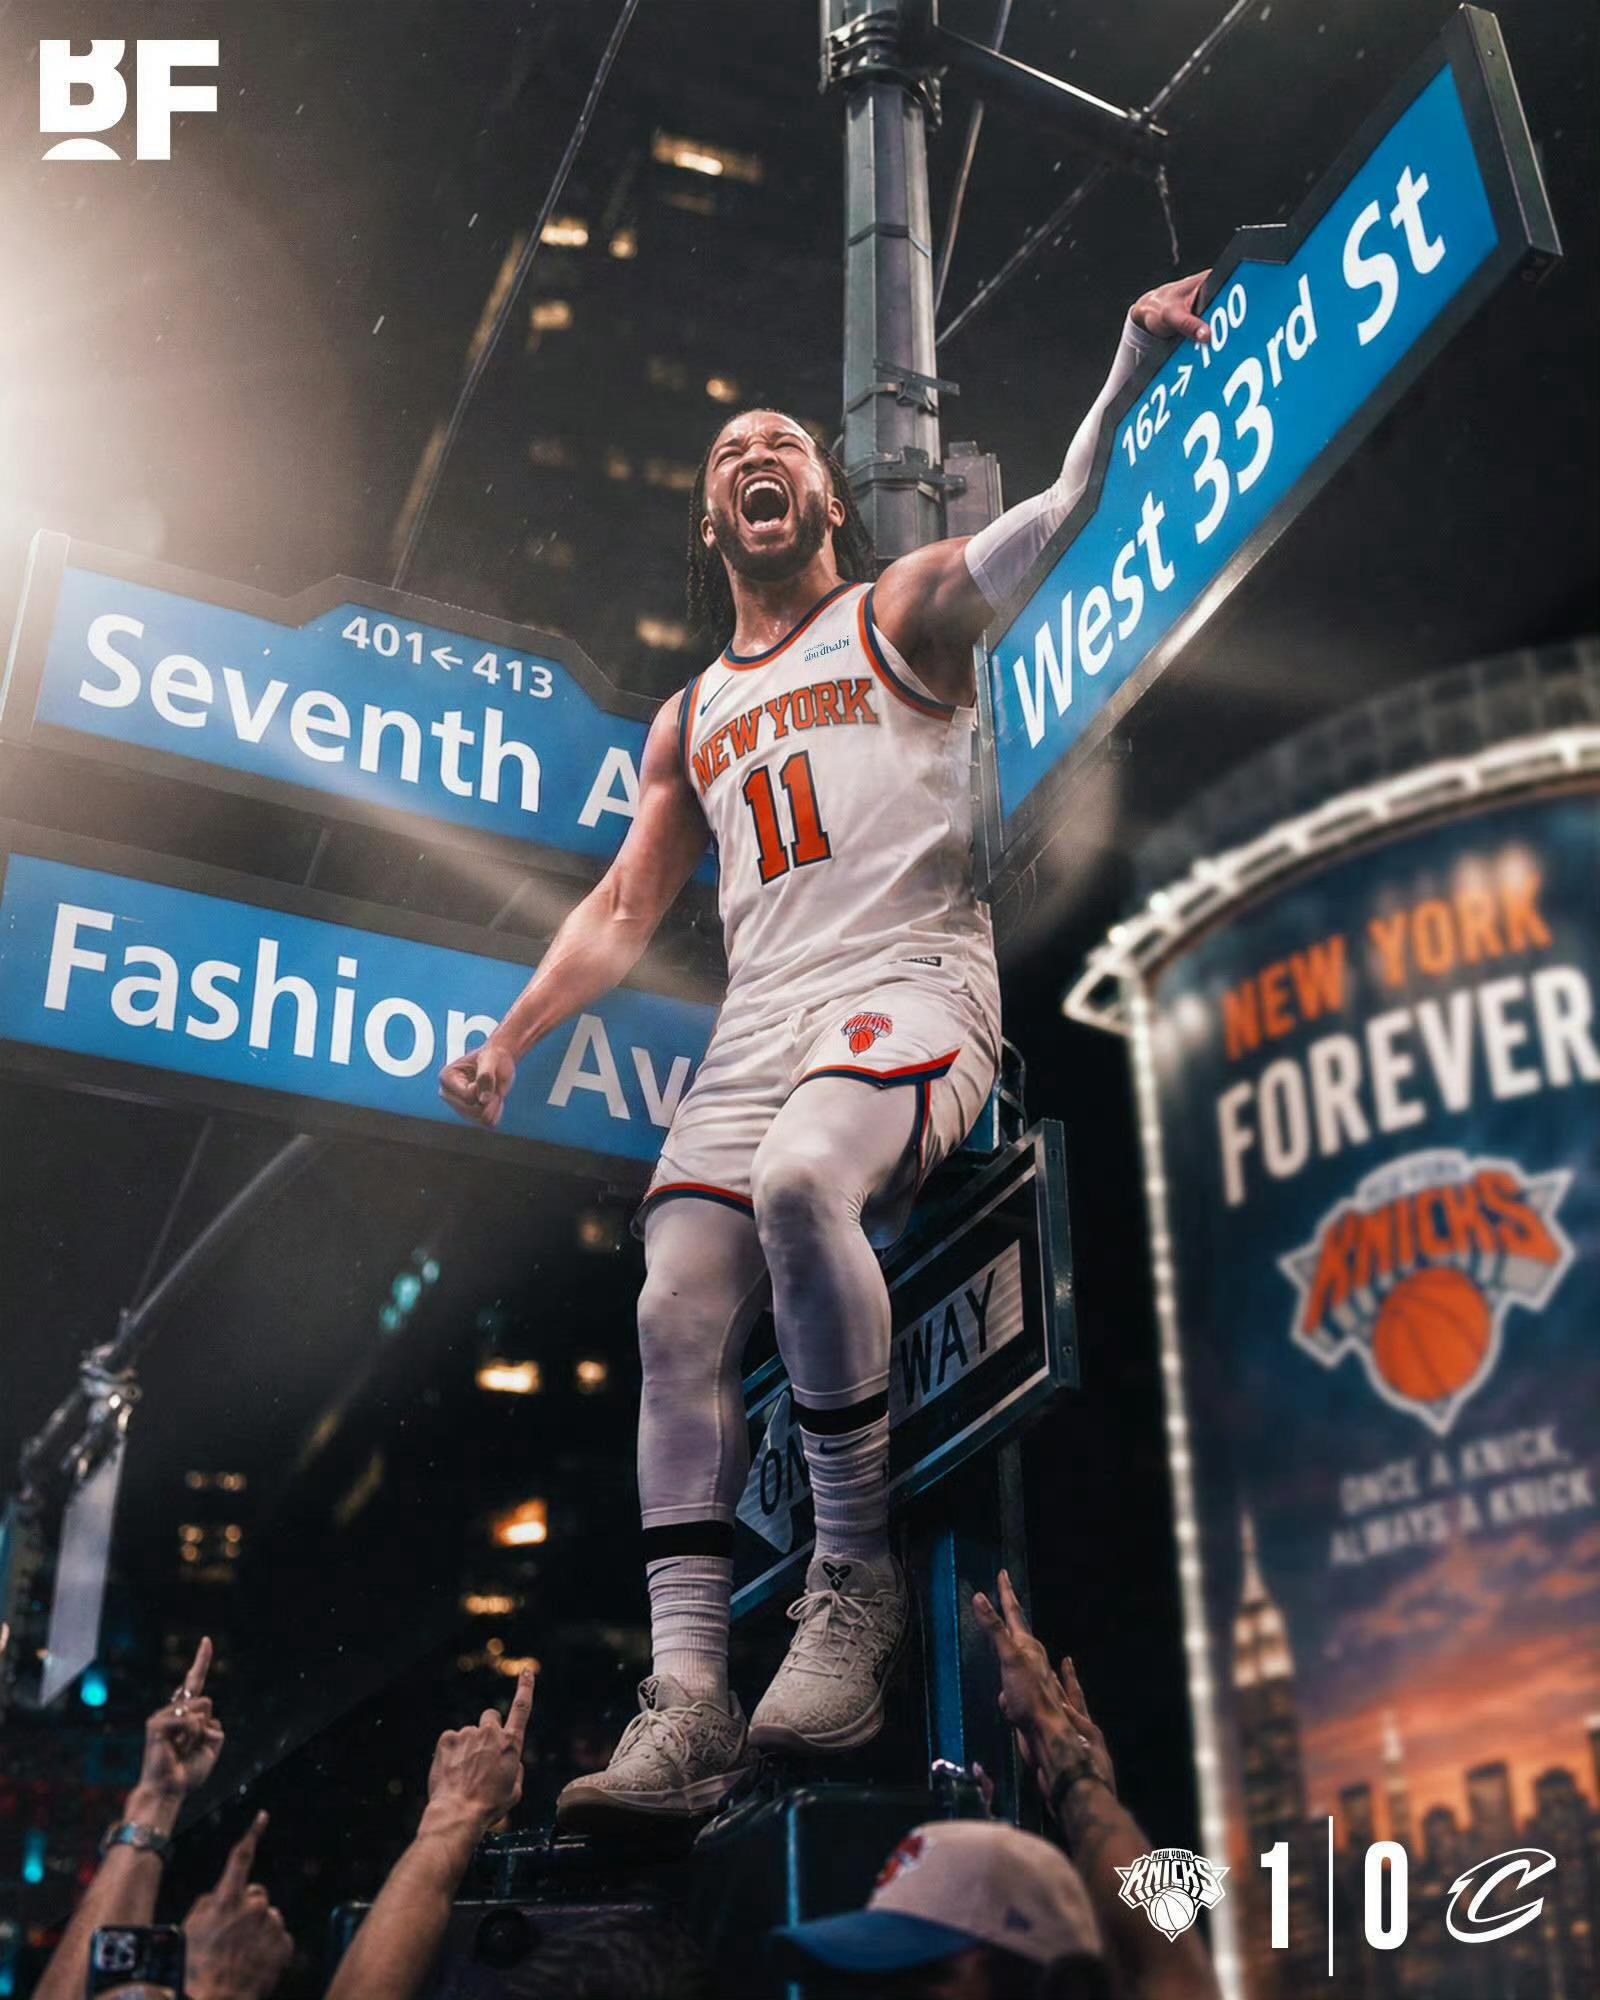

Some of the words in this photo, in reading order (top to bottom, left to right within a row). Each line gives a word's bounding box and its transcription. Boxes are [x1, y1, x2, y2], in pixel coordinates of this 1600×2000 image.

[1011, 490, 1176, 749] West
[1181, 273, 1318, 544] 33rd
[1341, 165, 1447, 347] St
[1121, 383, 1171, 467] 162
[78, 613, 543, 814] Seventh
[341, 614, 424, 665] 401
[471, 651, 554, 700] 413
[692, 706, 763, 799] NEW
[764, 677, 880, 740] YORK
[741, 749, 833, 886] 11
[1222, 934, 1347, 1063] NEW
[1366, 860, 1554, 990] YORK
[546, 1012, 692, 1129] Av
[1216, 964, 1600, 1207] FOREVER
[1302, 1167, 1562, 1334] KNICKS
[759, 1434, 809, 1517] ON
[900, 1267, 997, 1409] WAY
